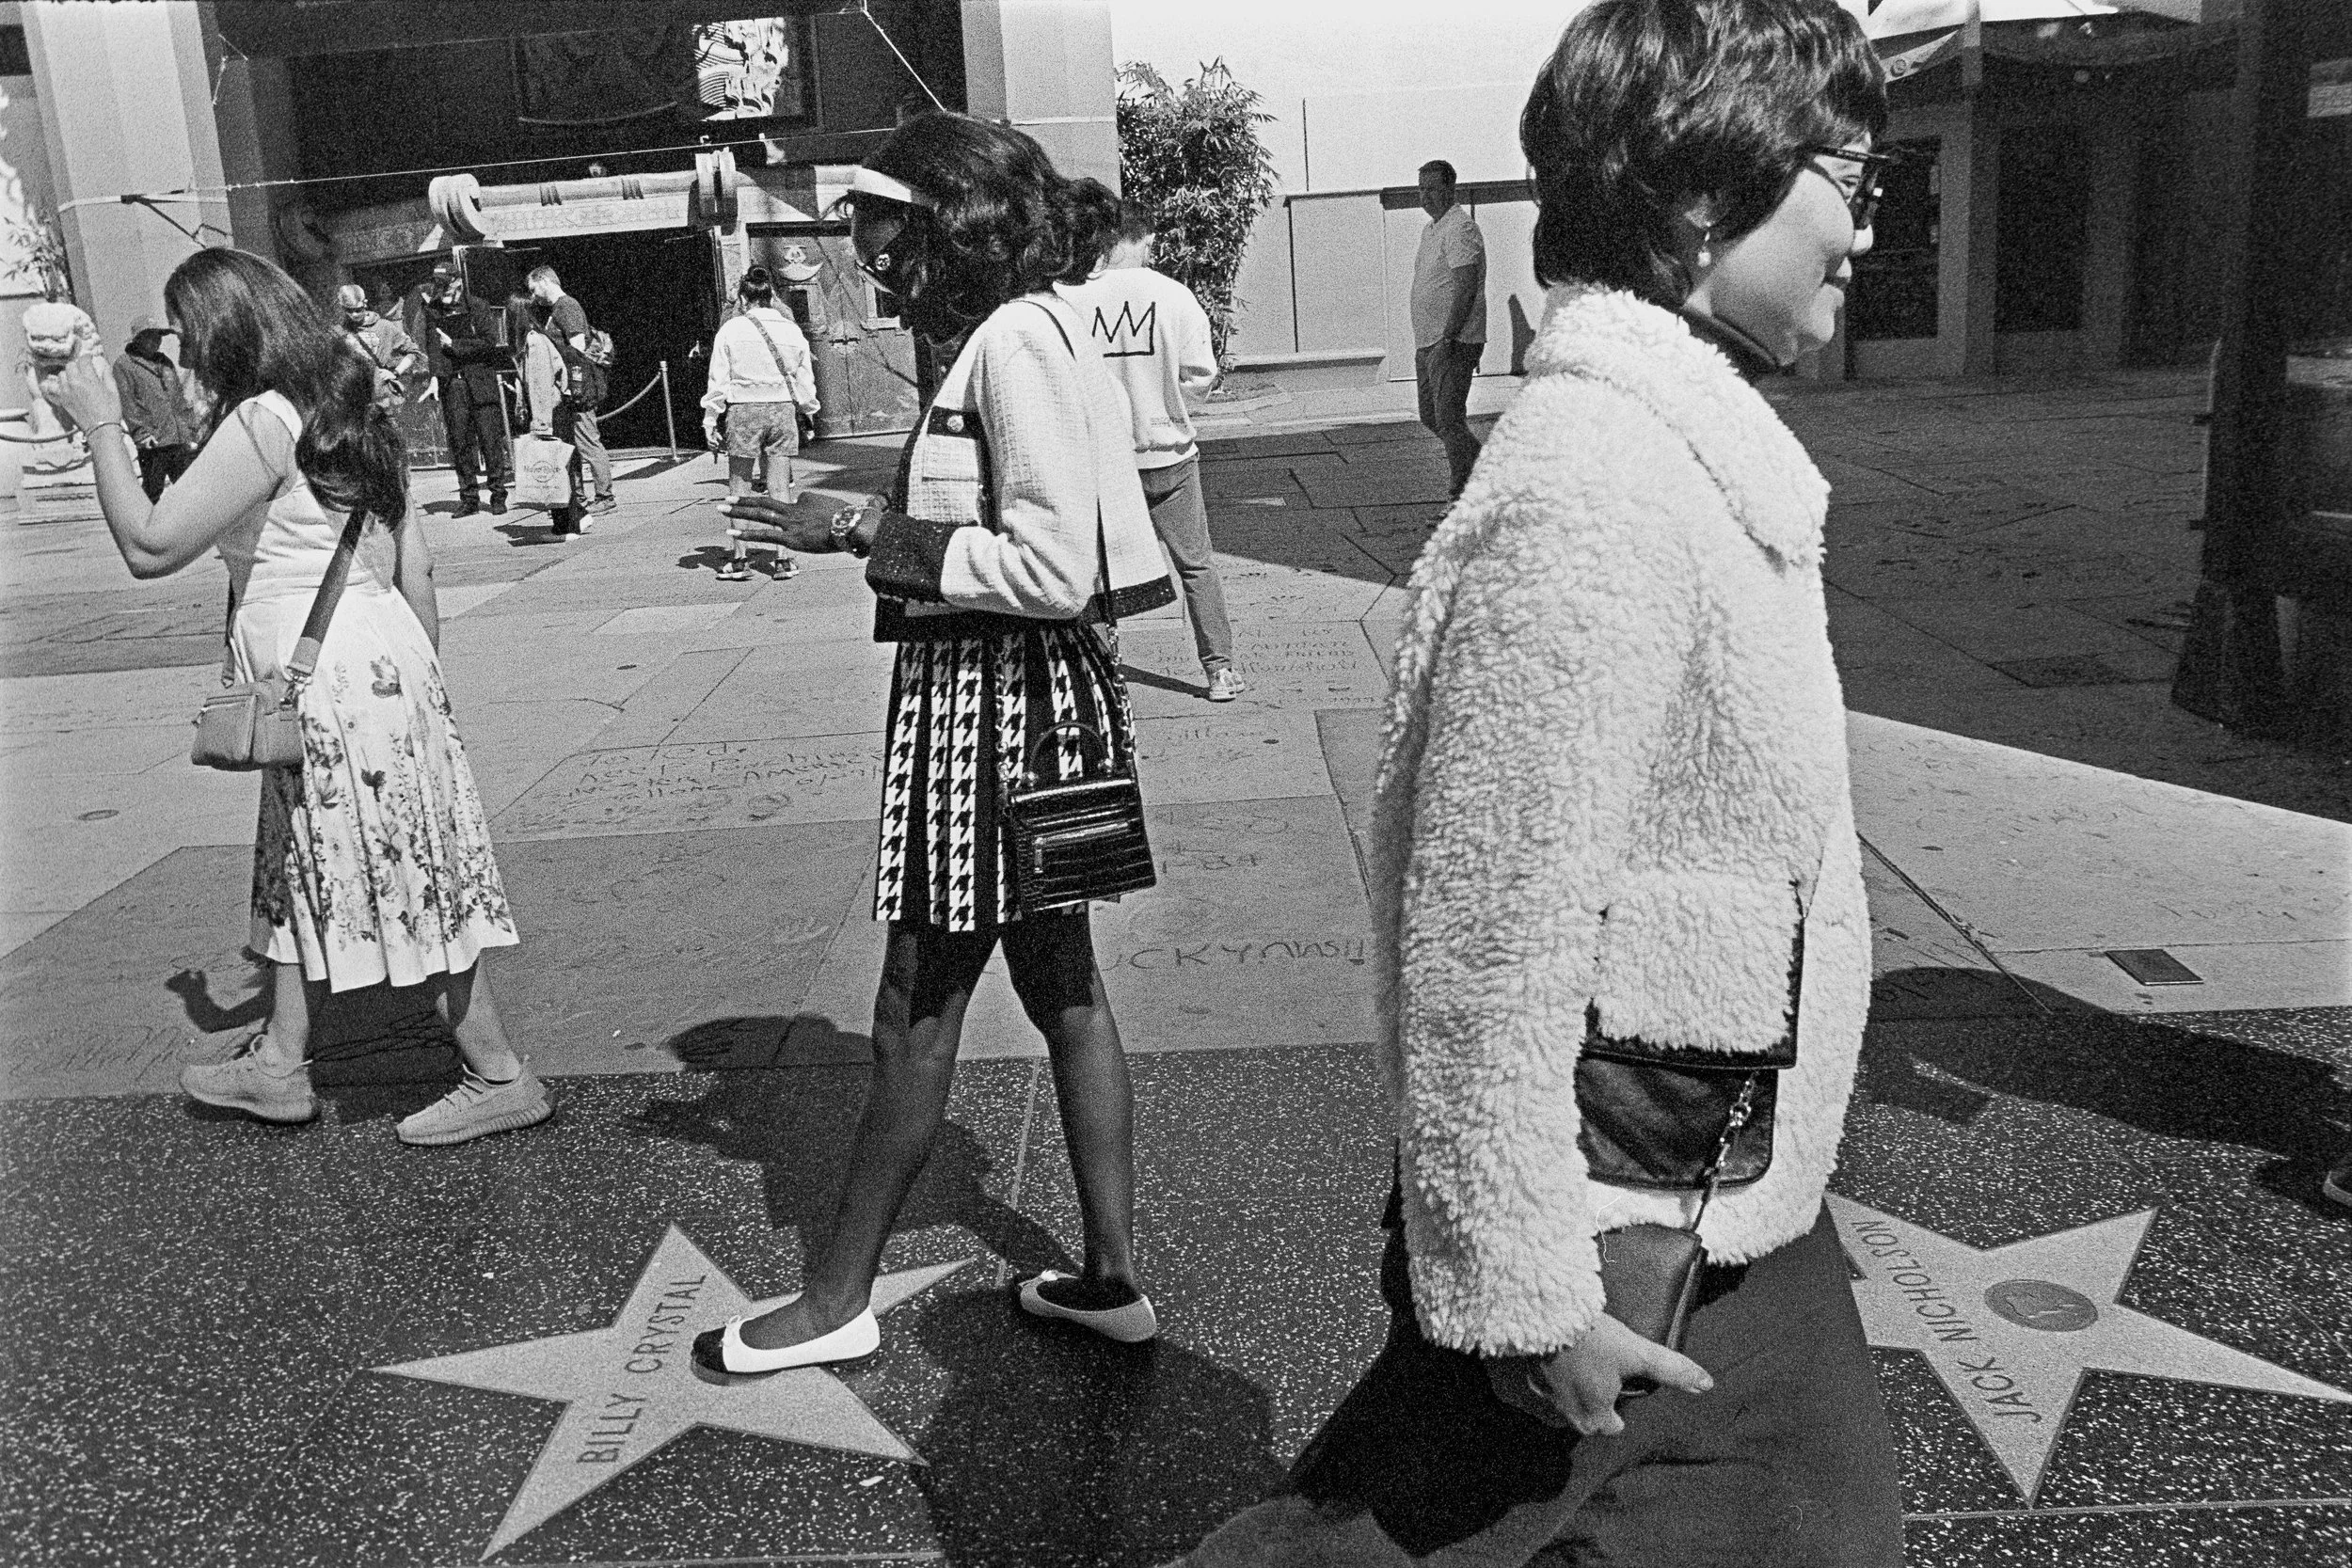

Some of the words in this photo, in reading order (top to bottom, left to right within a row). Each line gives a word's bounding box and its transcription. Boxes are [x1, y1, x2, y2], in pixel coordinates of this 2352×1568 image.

[1852, 1221, 1978, 1342] NICHOLSON
[576, 1393, 646, 1464] BILLY
[624, 1275, 706, 1373] CRYSTAL
[1957, 1357, 2042, 1423] JACK
